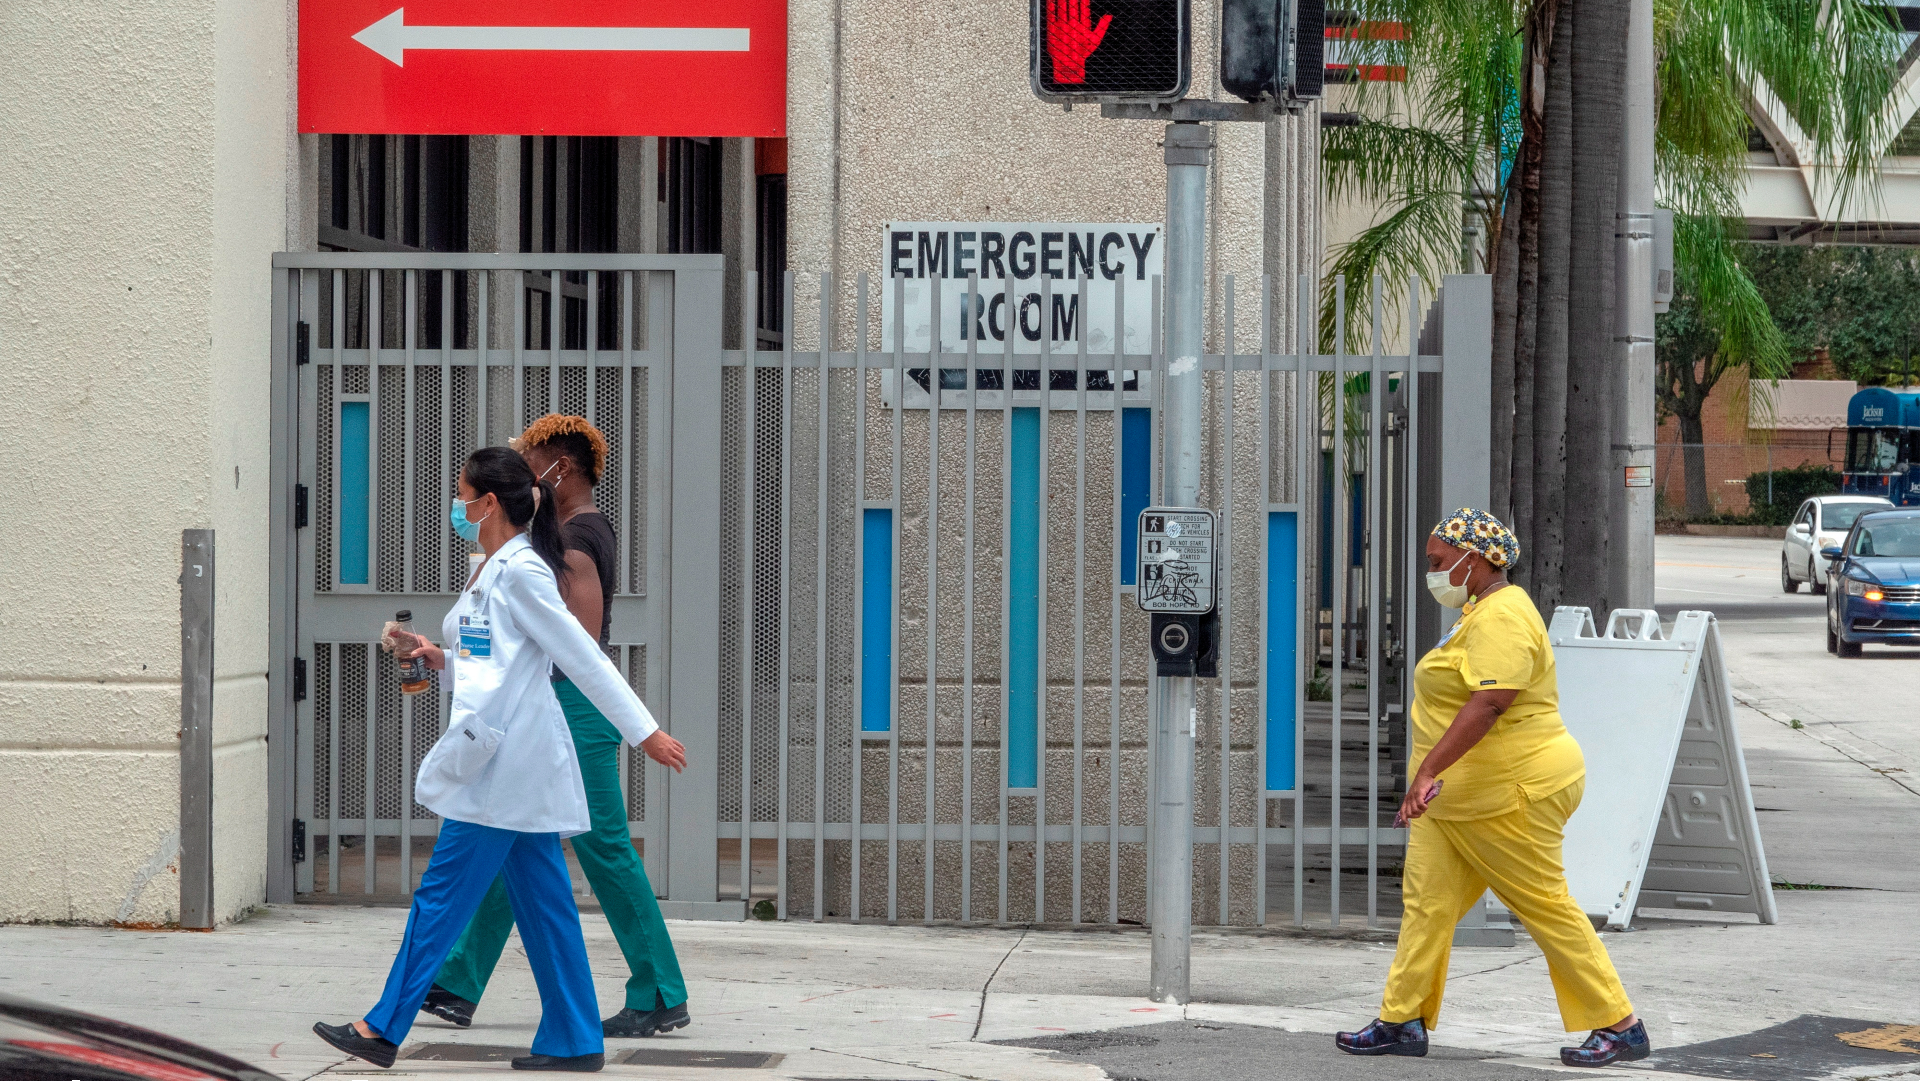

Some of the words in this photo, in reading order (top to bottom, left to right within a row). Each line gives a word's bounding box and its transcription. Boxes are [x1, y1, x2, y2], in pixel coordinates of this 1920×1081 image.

[890, 230, 1156, 281] EMERGENCY
[960, 291, 1080, 342] ROOM
[1862, 404, 1884, 420] Jackson
